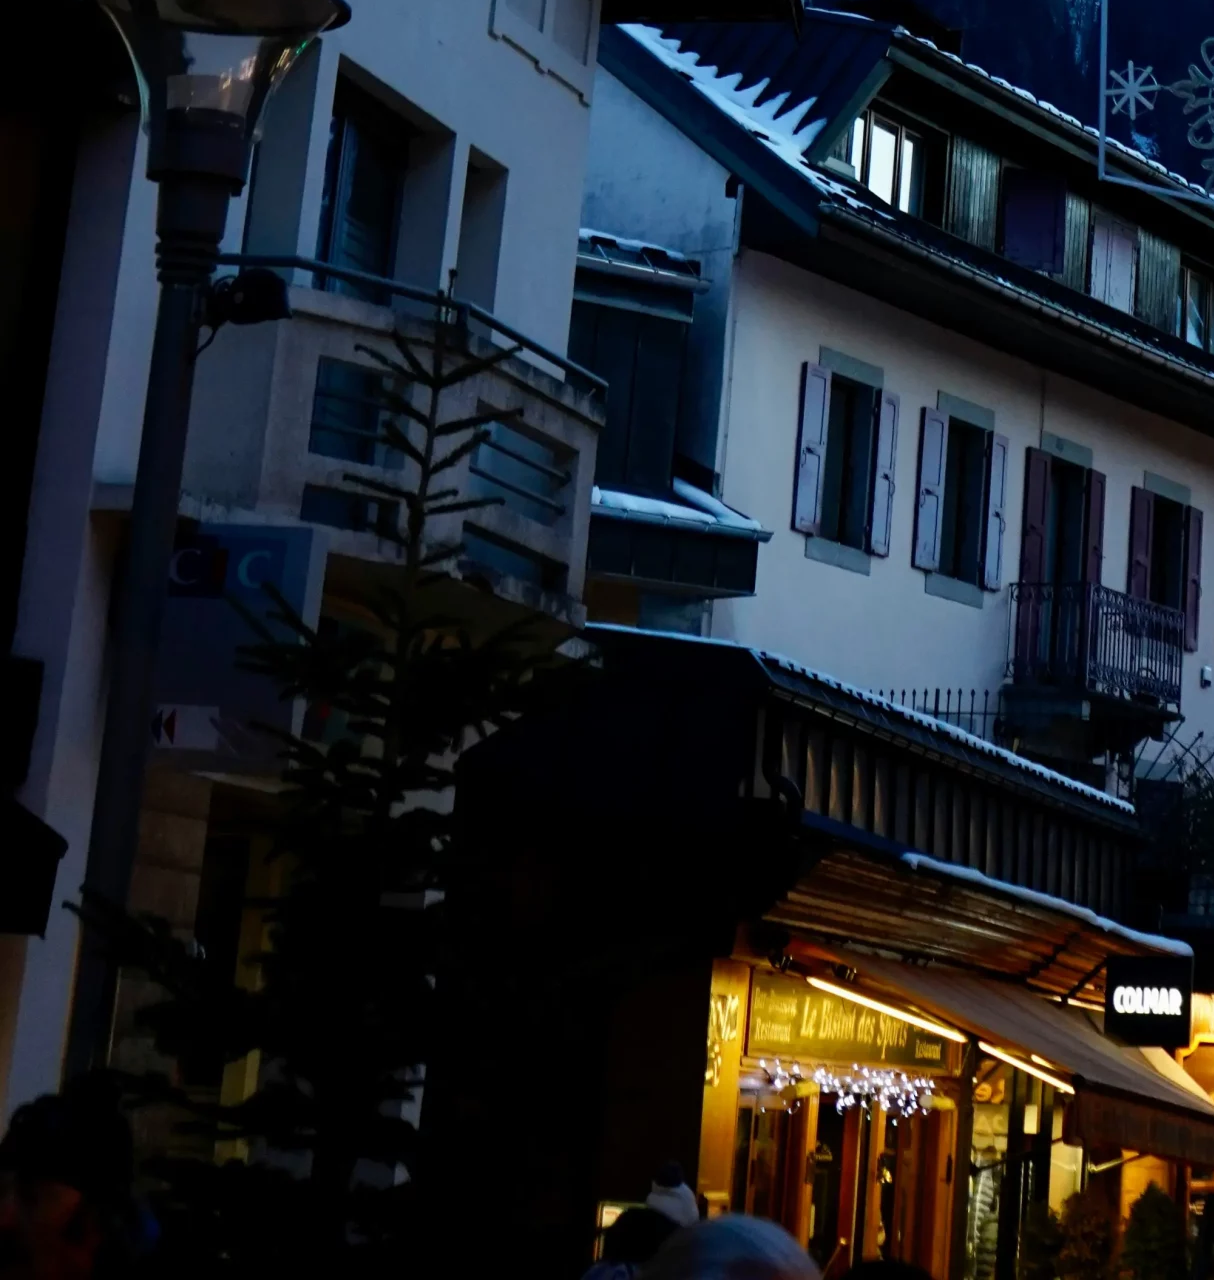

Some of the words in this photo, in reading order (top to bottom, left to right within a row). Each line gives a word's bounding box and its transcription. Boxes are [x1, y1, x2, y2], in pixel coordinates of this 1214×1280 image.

[801, 996, 818, 1039] Le
[819, 999, 856, 1041] Bistrot
[857, 1008, 876, 1045] des
[1113, 986, 1183, 1016] COLMAR
